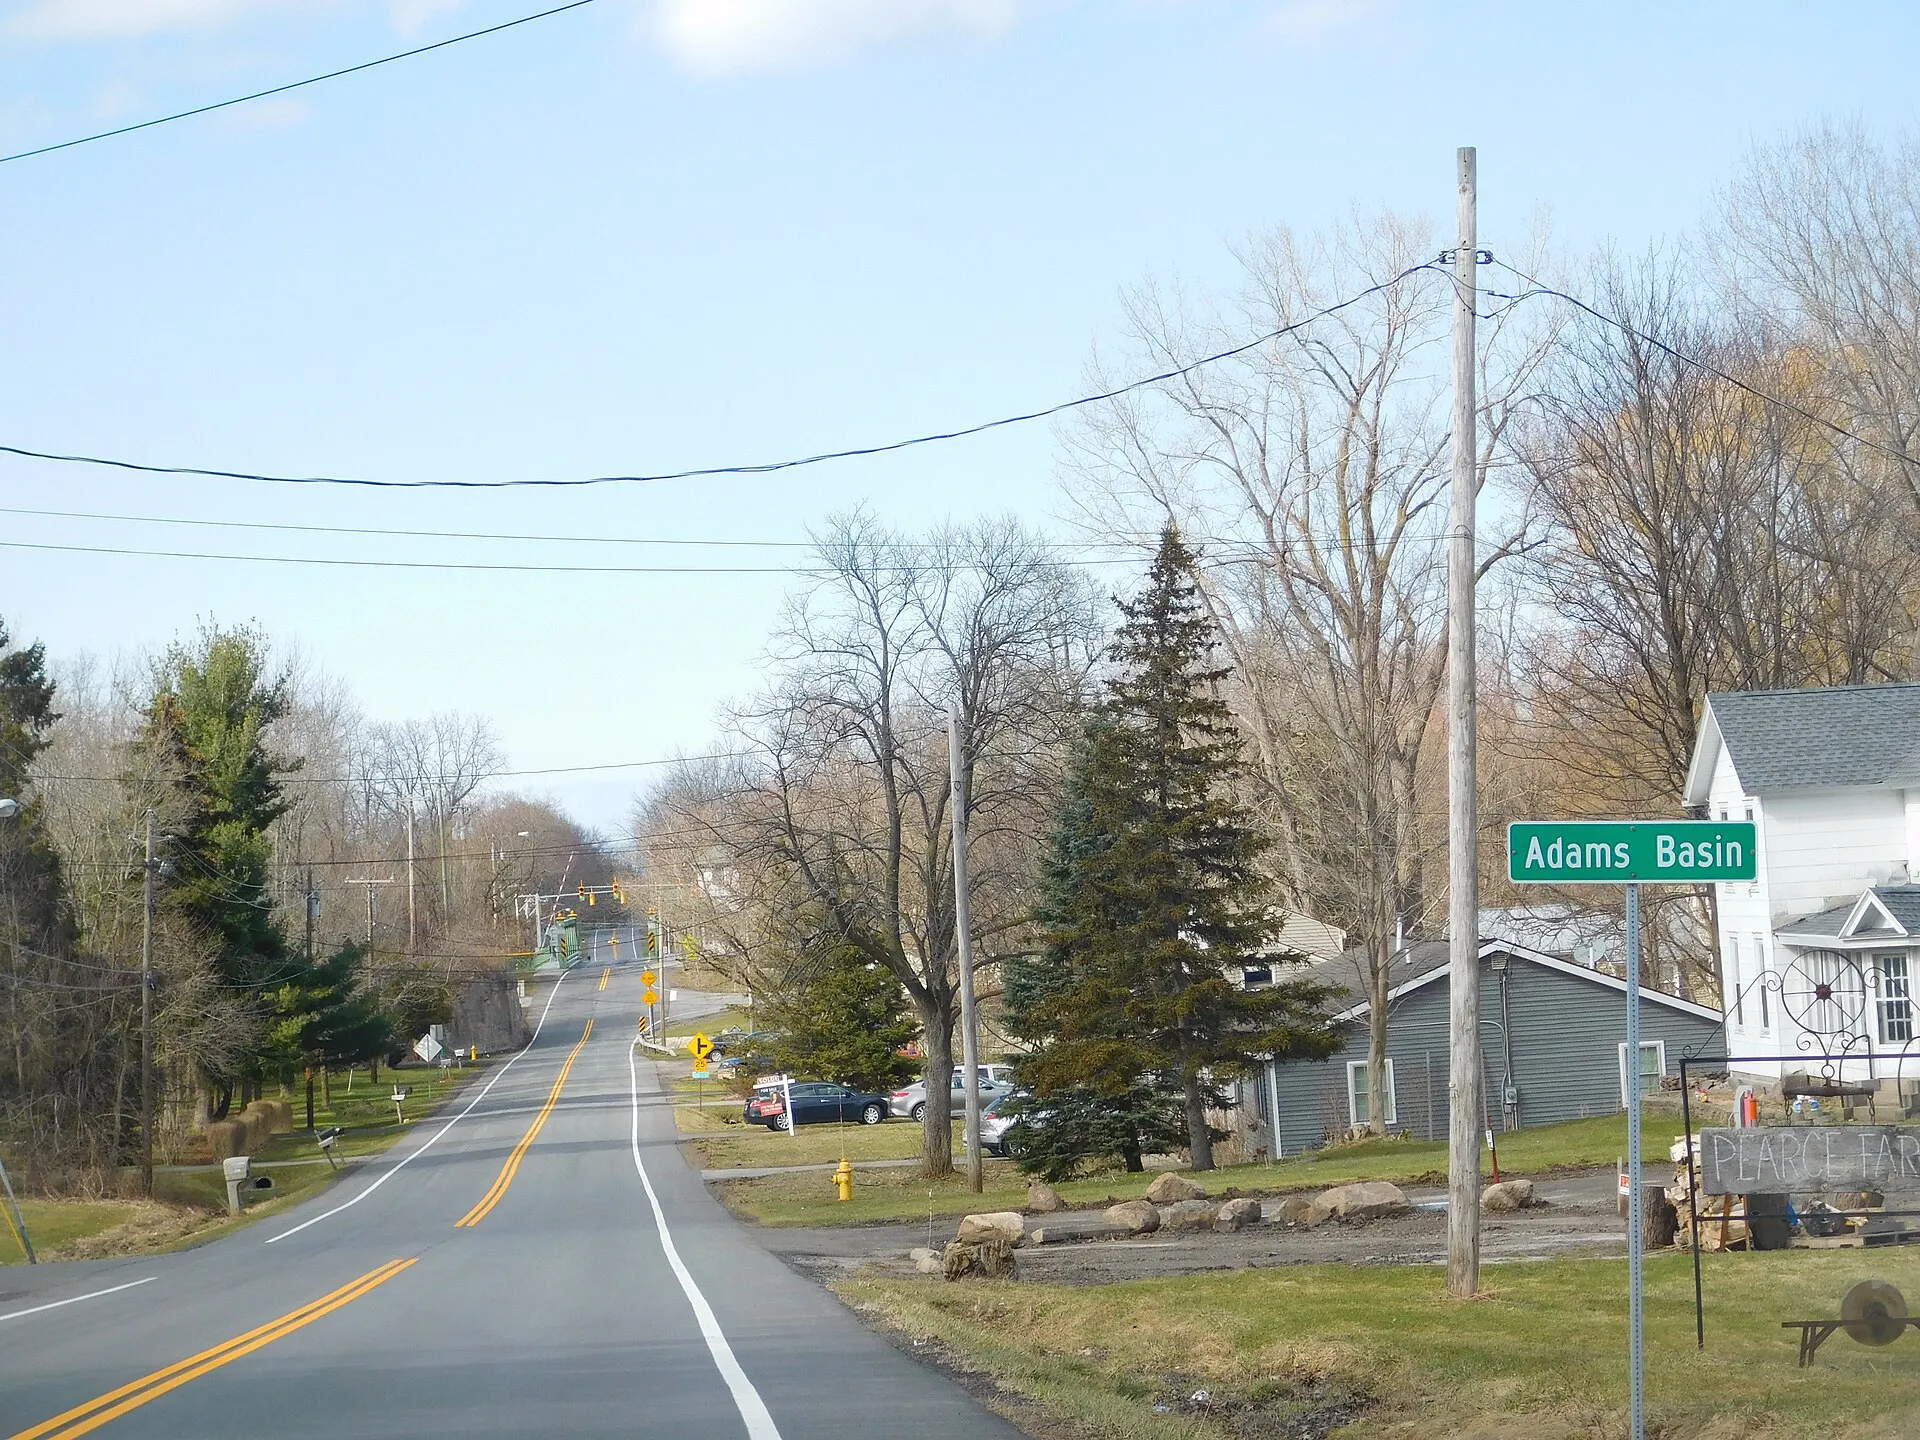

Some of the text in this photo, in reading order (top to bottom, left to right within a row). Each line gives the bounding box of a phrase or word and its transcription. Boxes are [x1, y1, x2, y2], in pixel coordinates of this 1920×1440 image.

[1525, 835, 1742, 868] Adams Basin
[1714, 1132, 1842, 1182] PEARCE
